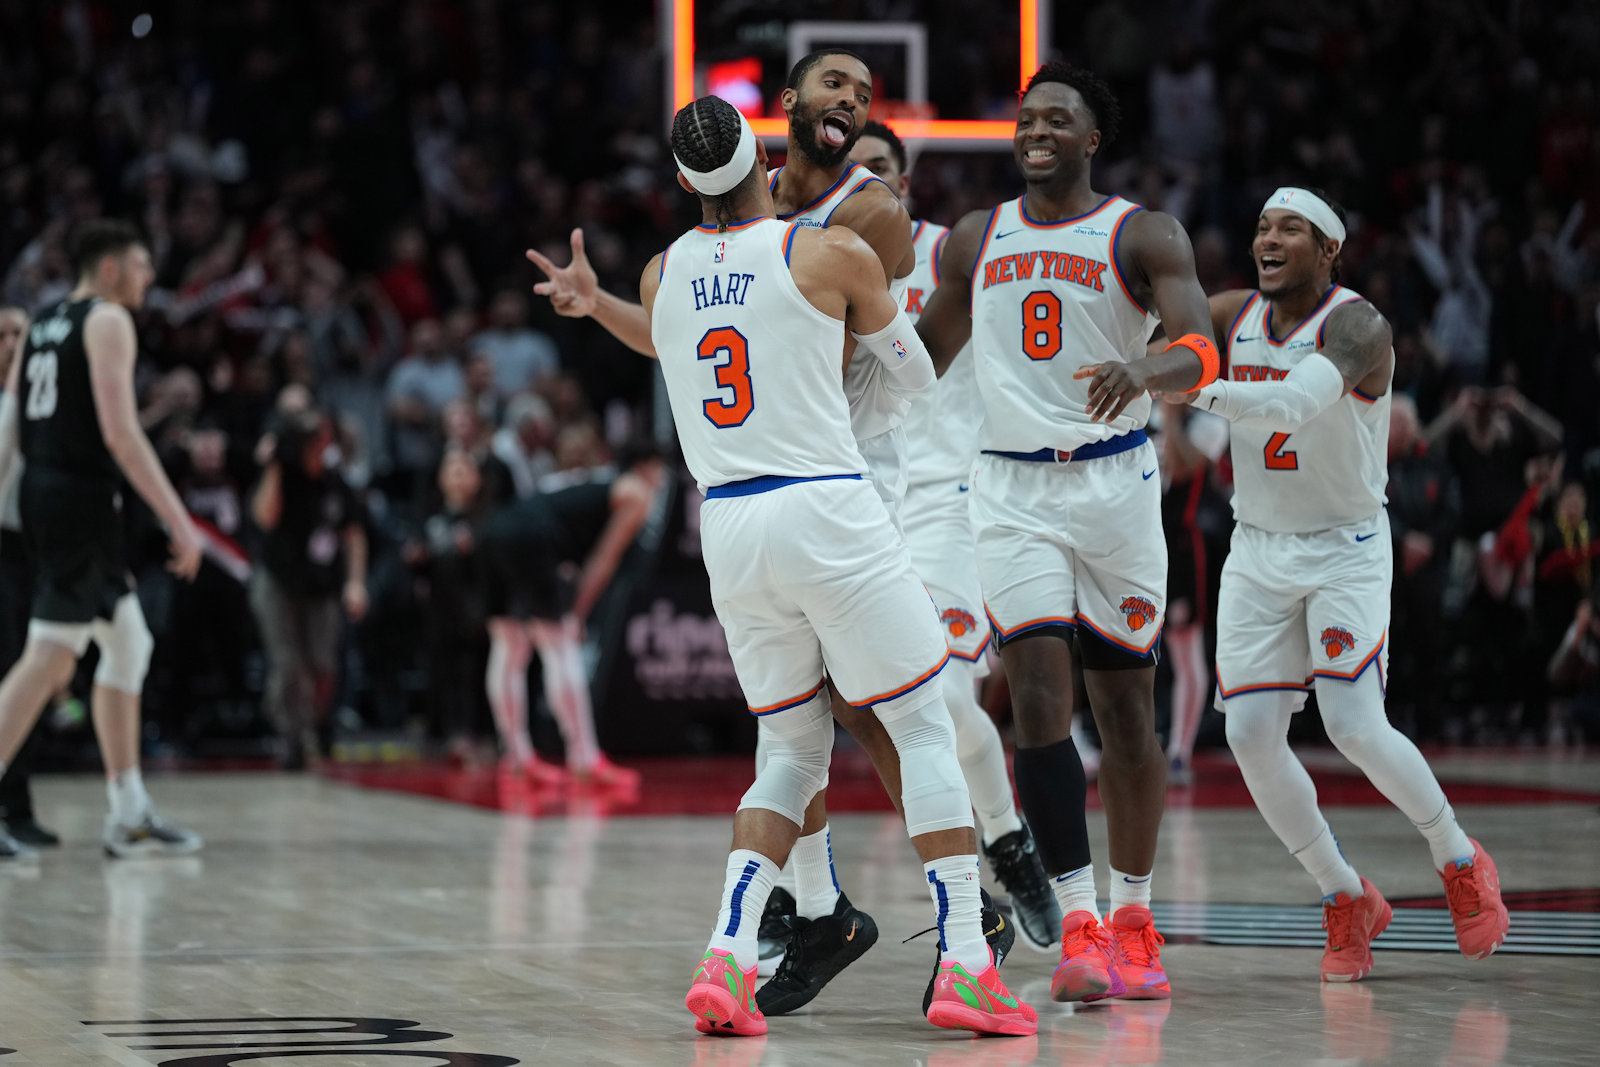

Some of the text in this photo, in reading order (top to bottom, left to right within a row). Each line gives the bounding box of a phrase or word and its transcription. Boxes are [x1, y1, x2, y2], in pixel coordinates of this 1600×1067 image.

[691, 273, 755, 311] HART
[983, 251, 1107, 293] NEW YORK
[1021, 290, 1062, 361] 8
[696, 325, 755, 429] 3
[1119, 596, 1156, 623] KNICKS
[1320, 627, 1355, 650] KNICKS
